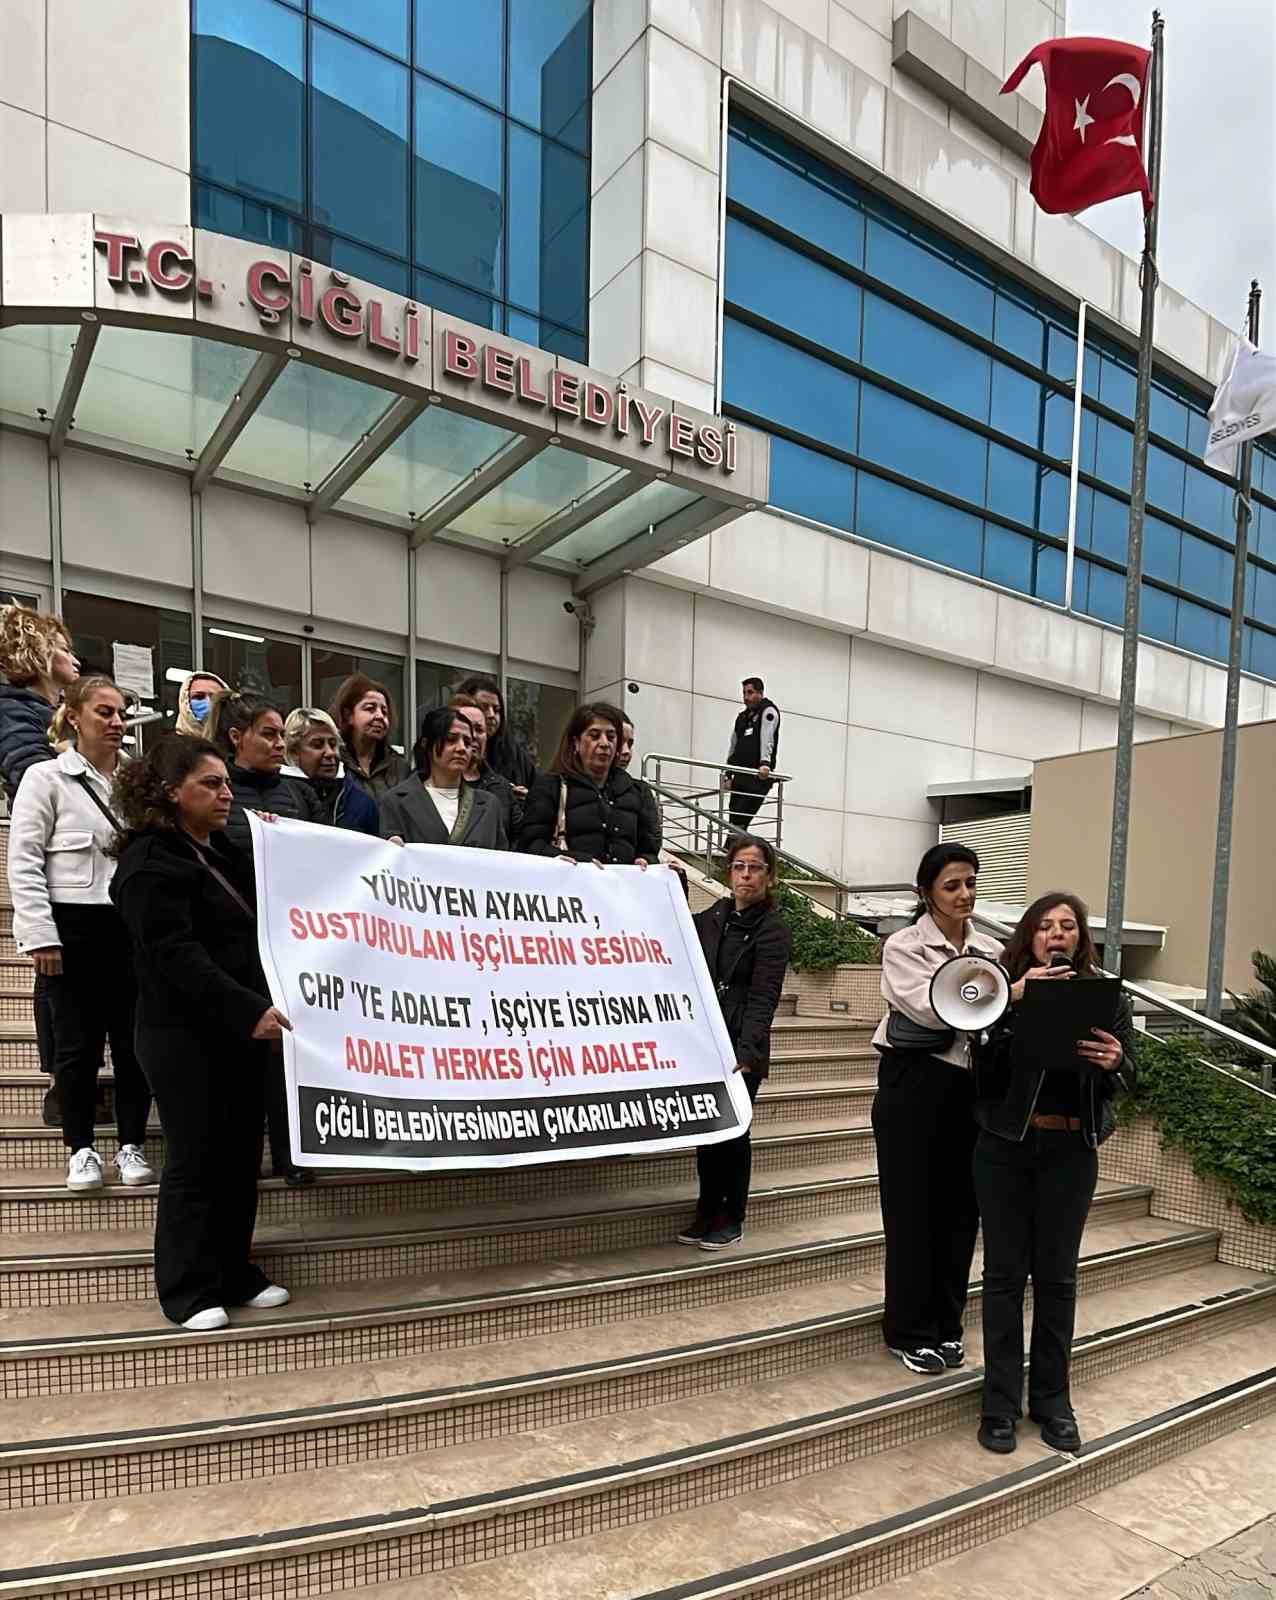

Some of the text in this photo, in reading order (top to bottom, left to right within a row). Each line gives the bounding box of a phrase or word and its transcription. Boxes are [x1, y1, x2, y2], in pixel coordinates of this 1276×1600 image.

[94, 231, 737, 472] T.C. ÇİĞLİ BELEDİYESİ
[360, 869, 478, 918] YÜRÜYEN
[289, 907, 673, 971] SUSTURULAN İŞÇİLERİN SESİDİR.
[299, 971, 344, 1011] CHP
[351, 980, 384, 1020] 'YE
[392, 990, 471, 1028] ADALET
[490, 990, 564, 1037] İŞÇİYE
[566, 990, 652, 1026] İSTİSNA
[655, 992, 681, 1022] MI
[345, 1036, 677, 1086] ADALET HERKES İÇİN ADALET...
[315, 1090, 720, 1144] ÇİĞLİ BELEDİYESİNDEN ÇIKARILAN İŞÇİLER
